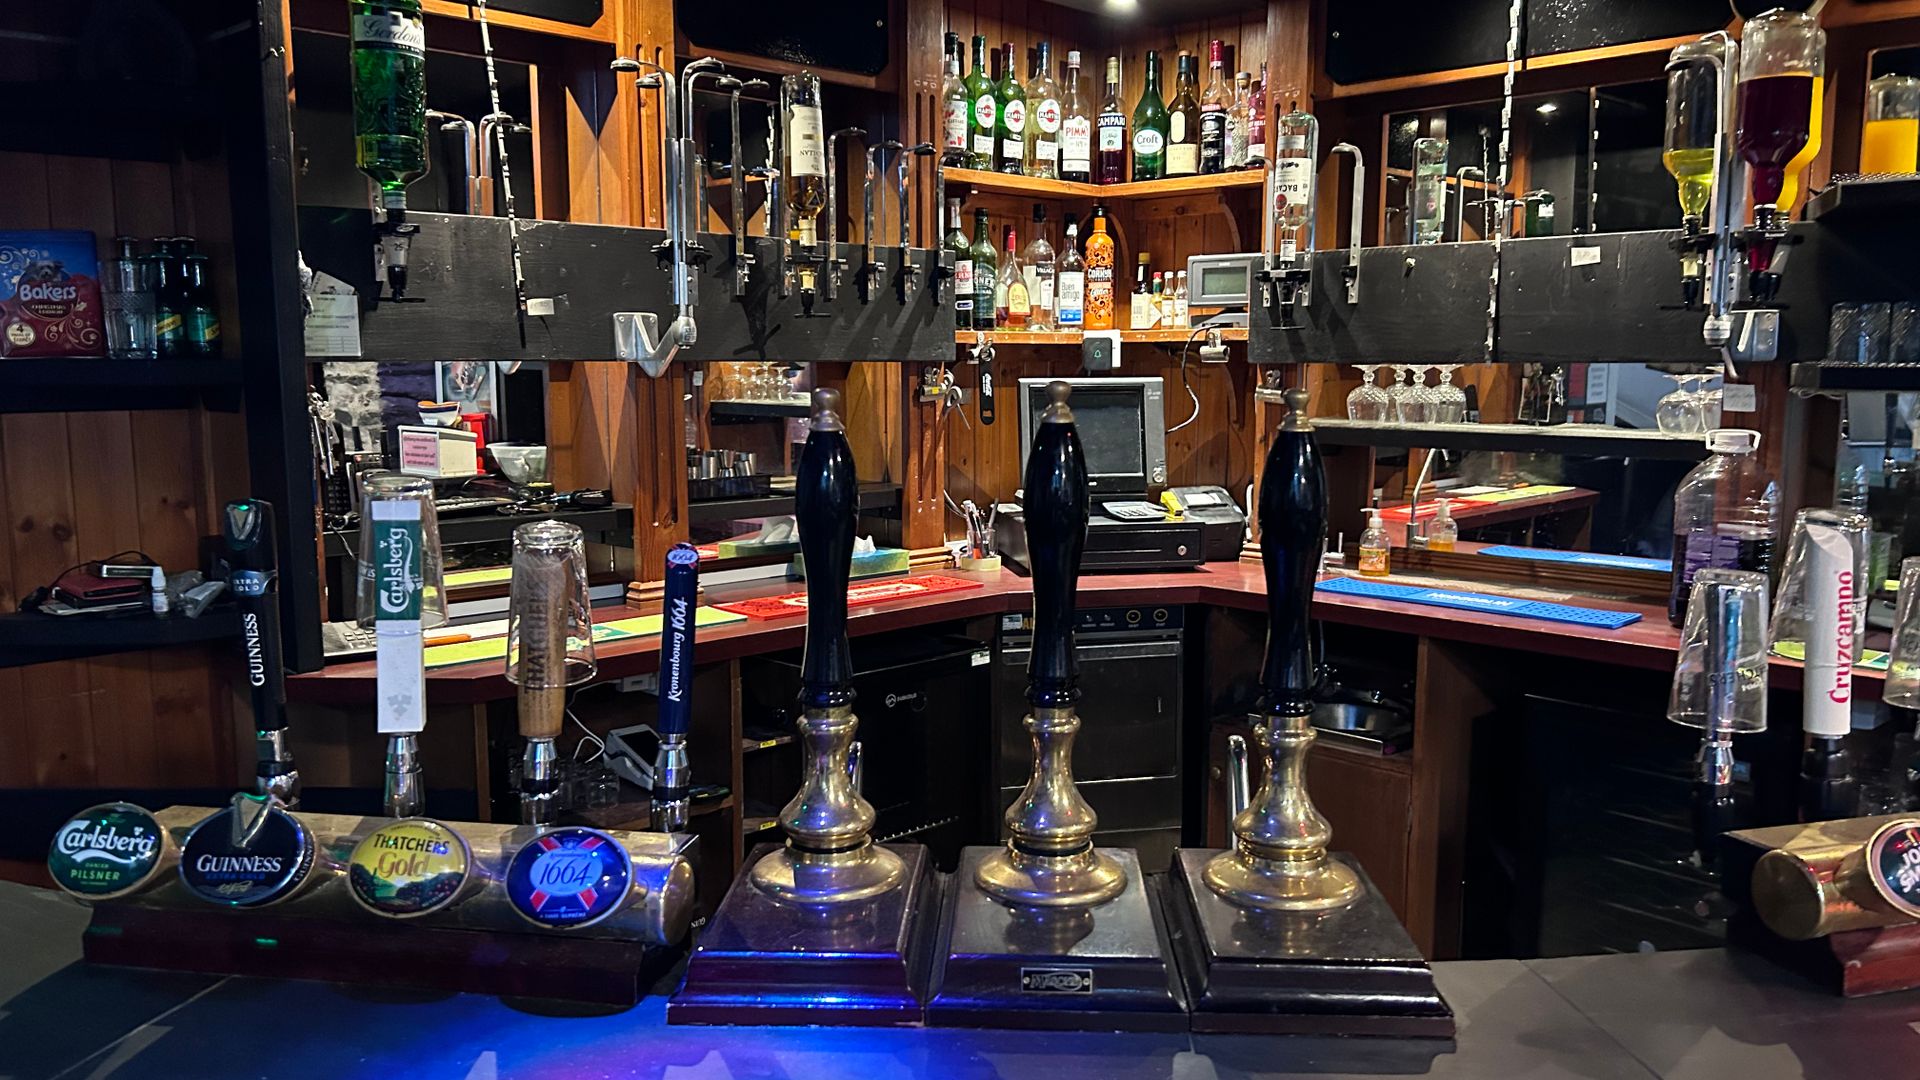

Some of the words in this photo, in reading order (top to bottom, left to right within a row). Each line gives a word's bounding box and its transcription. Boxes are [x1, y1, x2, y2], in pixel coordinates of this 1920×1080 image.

[363, 18, 421, 43] Gordon's
[1097, 116, 1126, 127] CAMPARI
[1136, 133, 1158, 145] Croft
[20, 282, 77, 302] Bakers
[380, 527, 409, 613] Carlsberg
[670, 596, 689, 631] 1664
[242, 612, 266, 687] GUINNESS
[1828, 571, 1853, 704] Cruzcampo
[667, 631, 686, 703] Kronenbourg
[57, 820, 156, 860] Carlsberg
[373, 834, 450, 855] THATCHERS
[70, 868, 121, 881] PILSNER
[196, 853, 283, 873] GUINNESS
[378, 851, 430, 878] Gold
[539, 858, 593, 887] 1664
